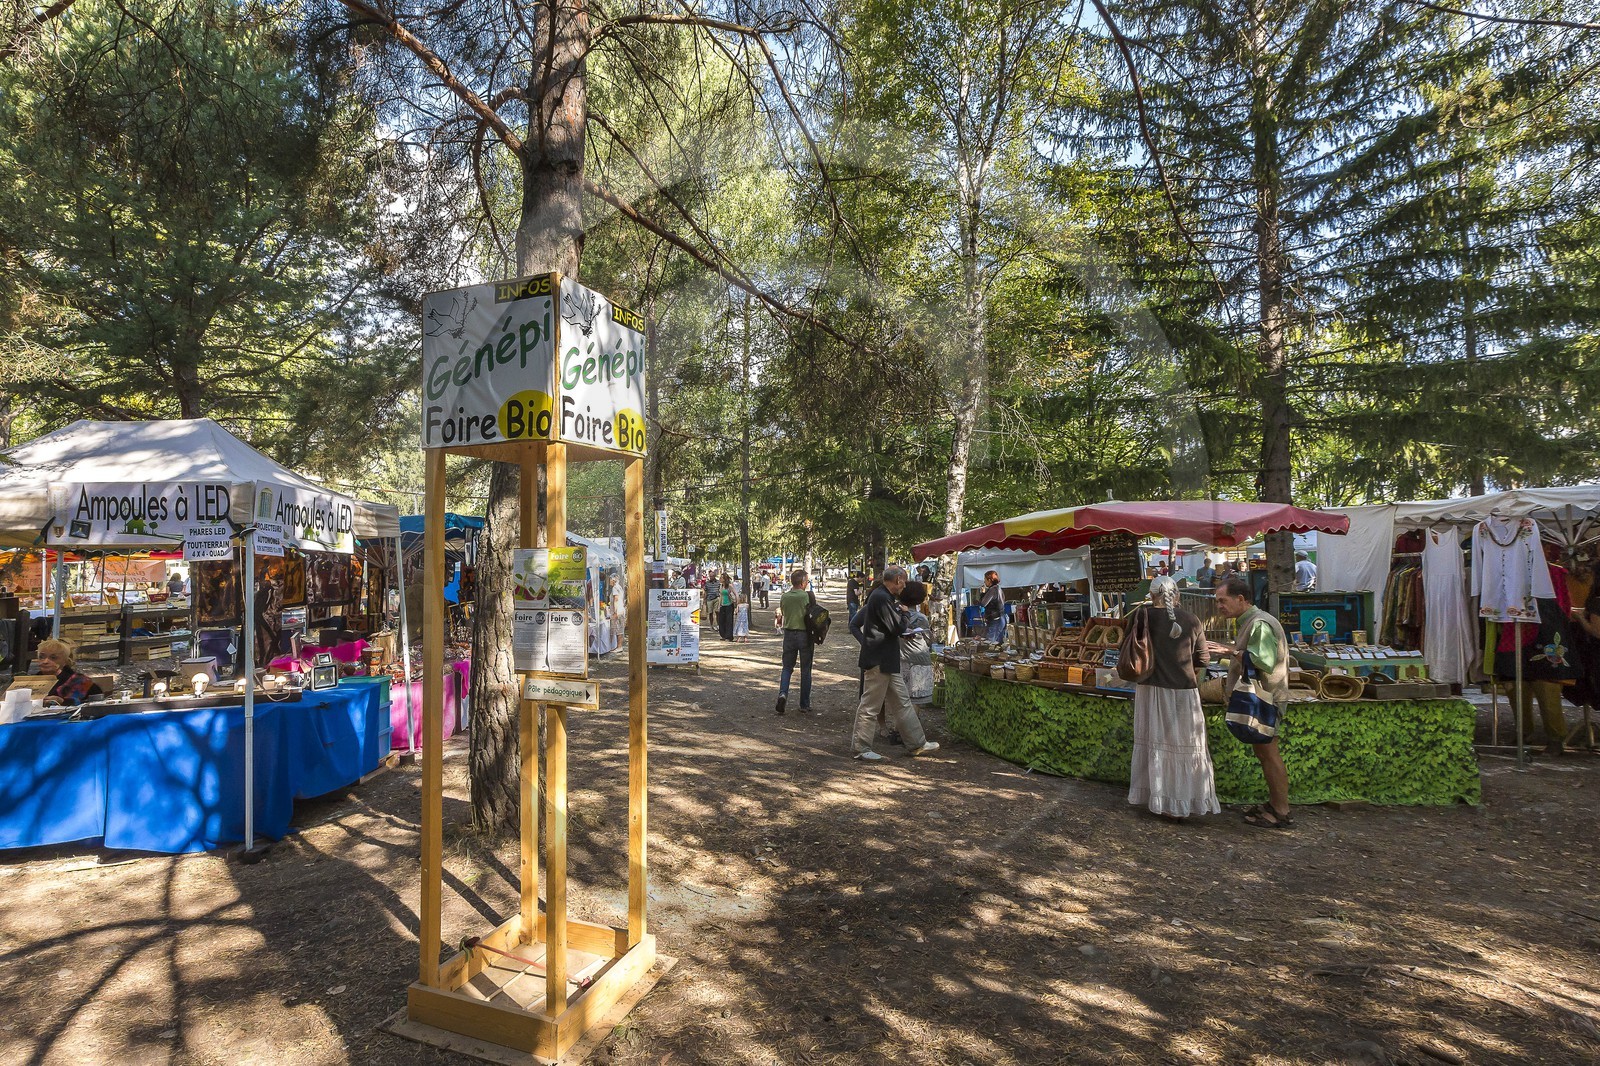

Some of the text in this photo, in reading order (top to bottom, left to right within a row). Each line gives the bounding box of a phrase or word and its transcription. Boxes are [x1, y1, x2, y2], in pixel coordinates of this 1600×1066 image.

[498, 279, 551, 300] INFOS
[613, 306, 644, 332] INFOS
[427, 300, 550, 401] Génépi
[562, 338, 644, 390] Génépi
[426, 400, 552, 444] Foire Bio
[562, 395, 644, 452] Foire Bio
[76, 484, 230, 530] Ampoules à LED
[275, 490, 352, 536] Ampoules à LED
[187, 540, 230, 549] TOUT-TERRAIN
[515, 612, 532, 621] Foire
[551, 612, 568, 622] Foire
[528, 684, 582, 698] Pôle pédagogique
